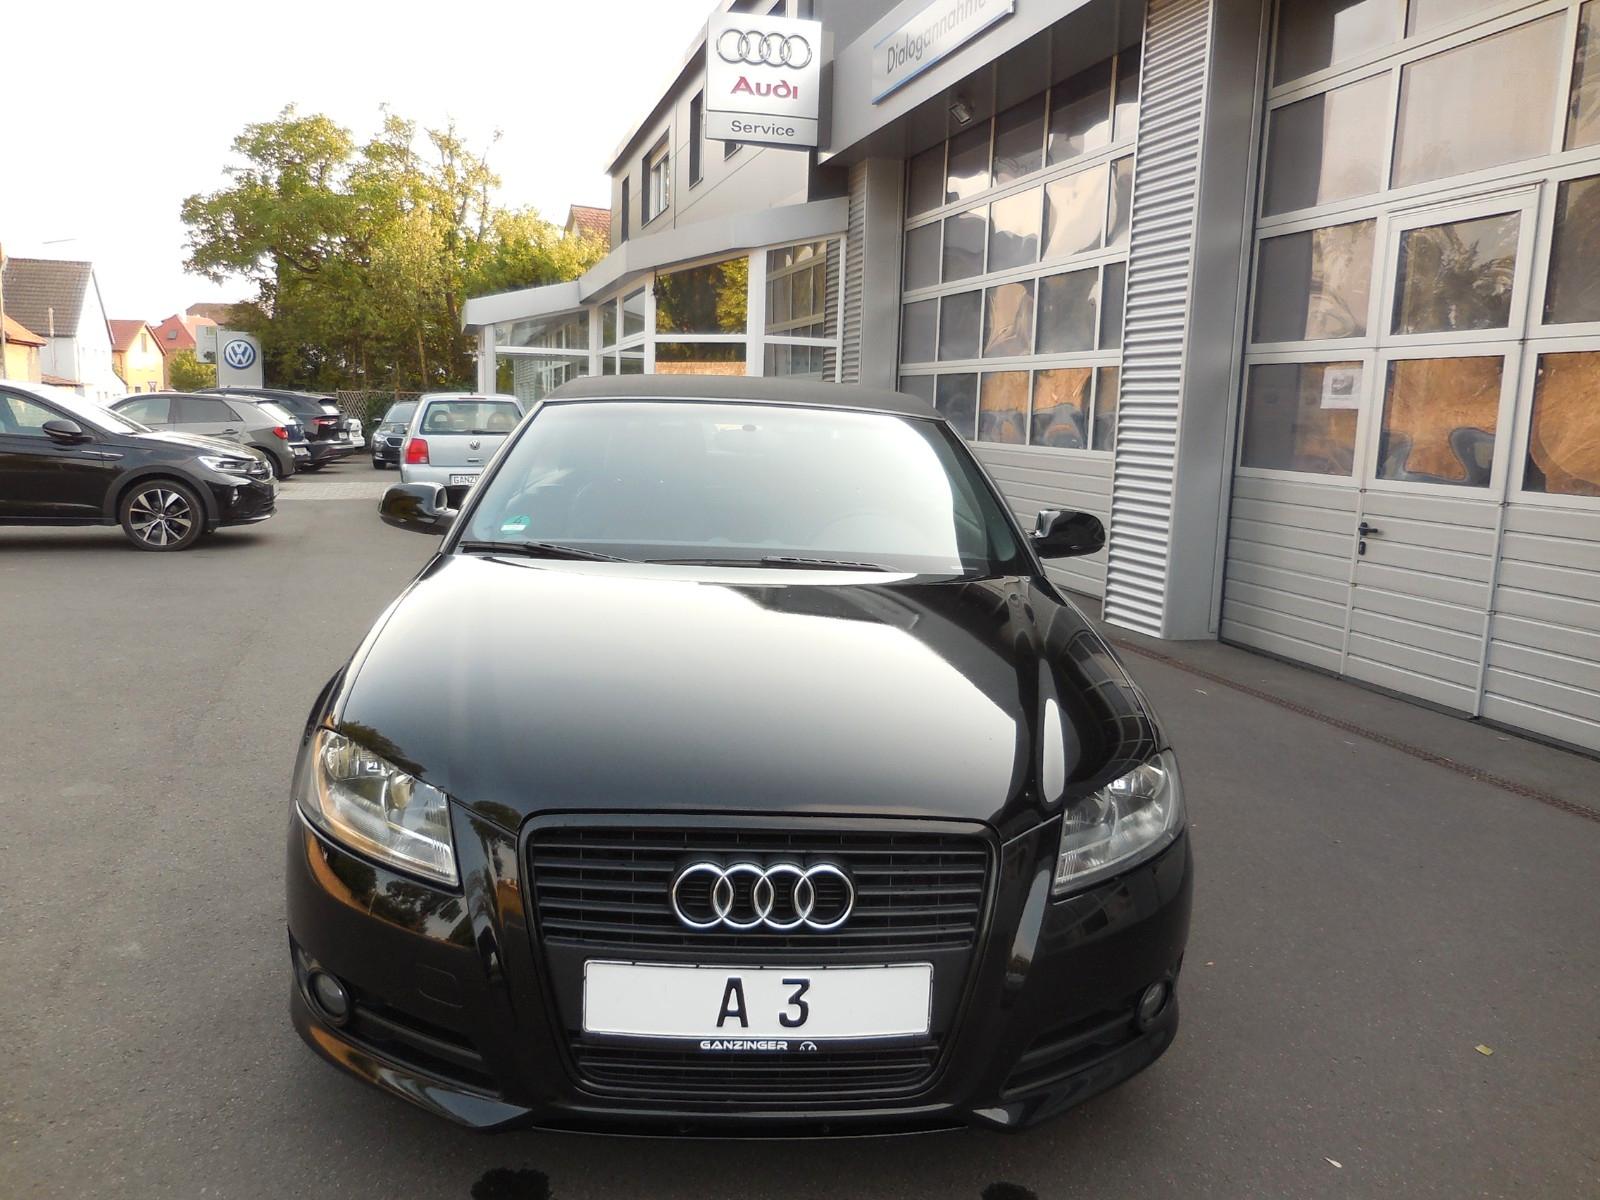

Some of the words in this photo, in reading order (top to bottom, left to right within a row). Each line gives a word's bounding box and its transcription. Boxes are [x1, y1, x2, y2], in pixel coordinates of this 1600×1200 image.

[730, 76, 799, 99] Audi
[731, 120, 795, 136] Service
[716, 977, 749, 1028] A
[779, 978, 810, 1028] 3
[700, 1040, 788, 1050] GANZINGER
